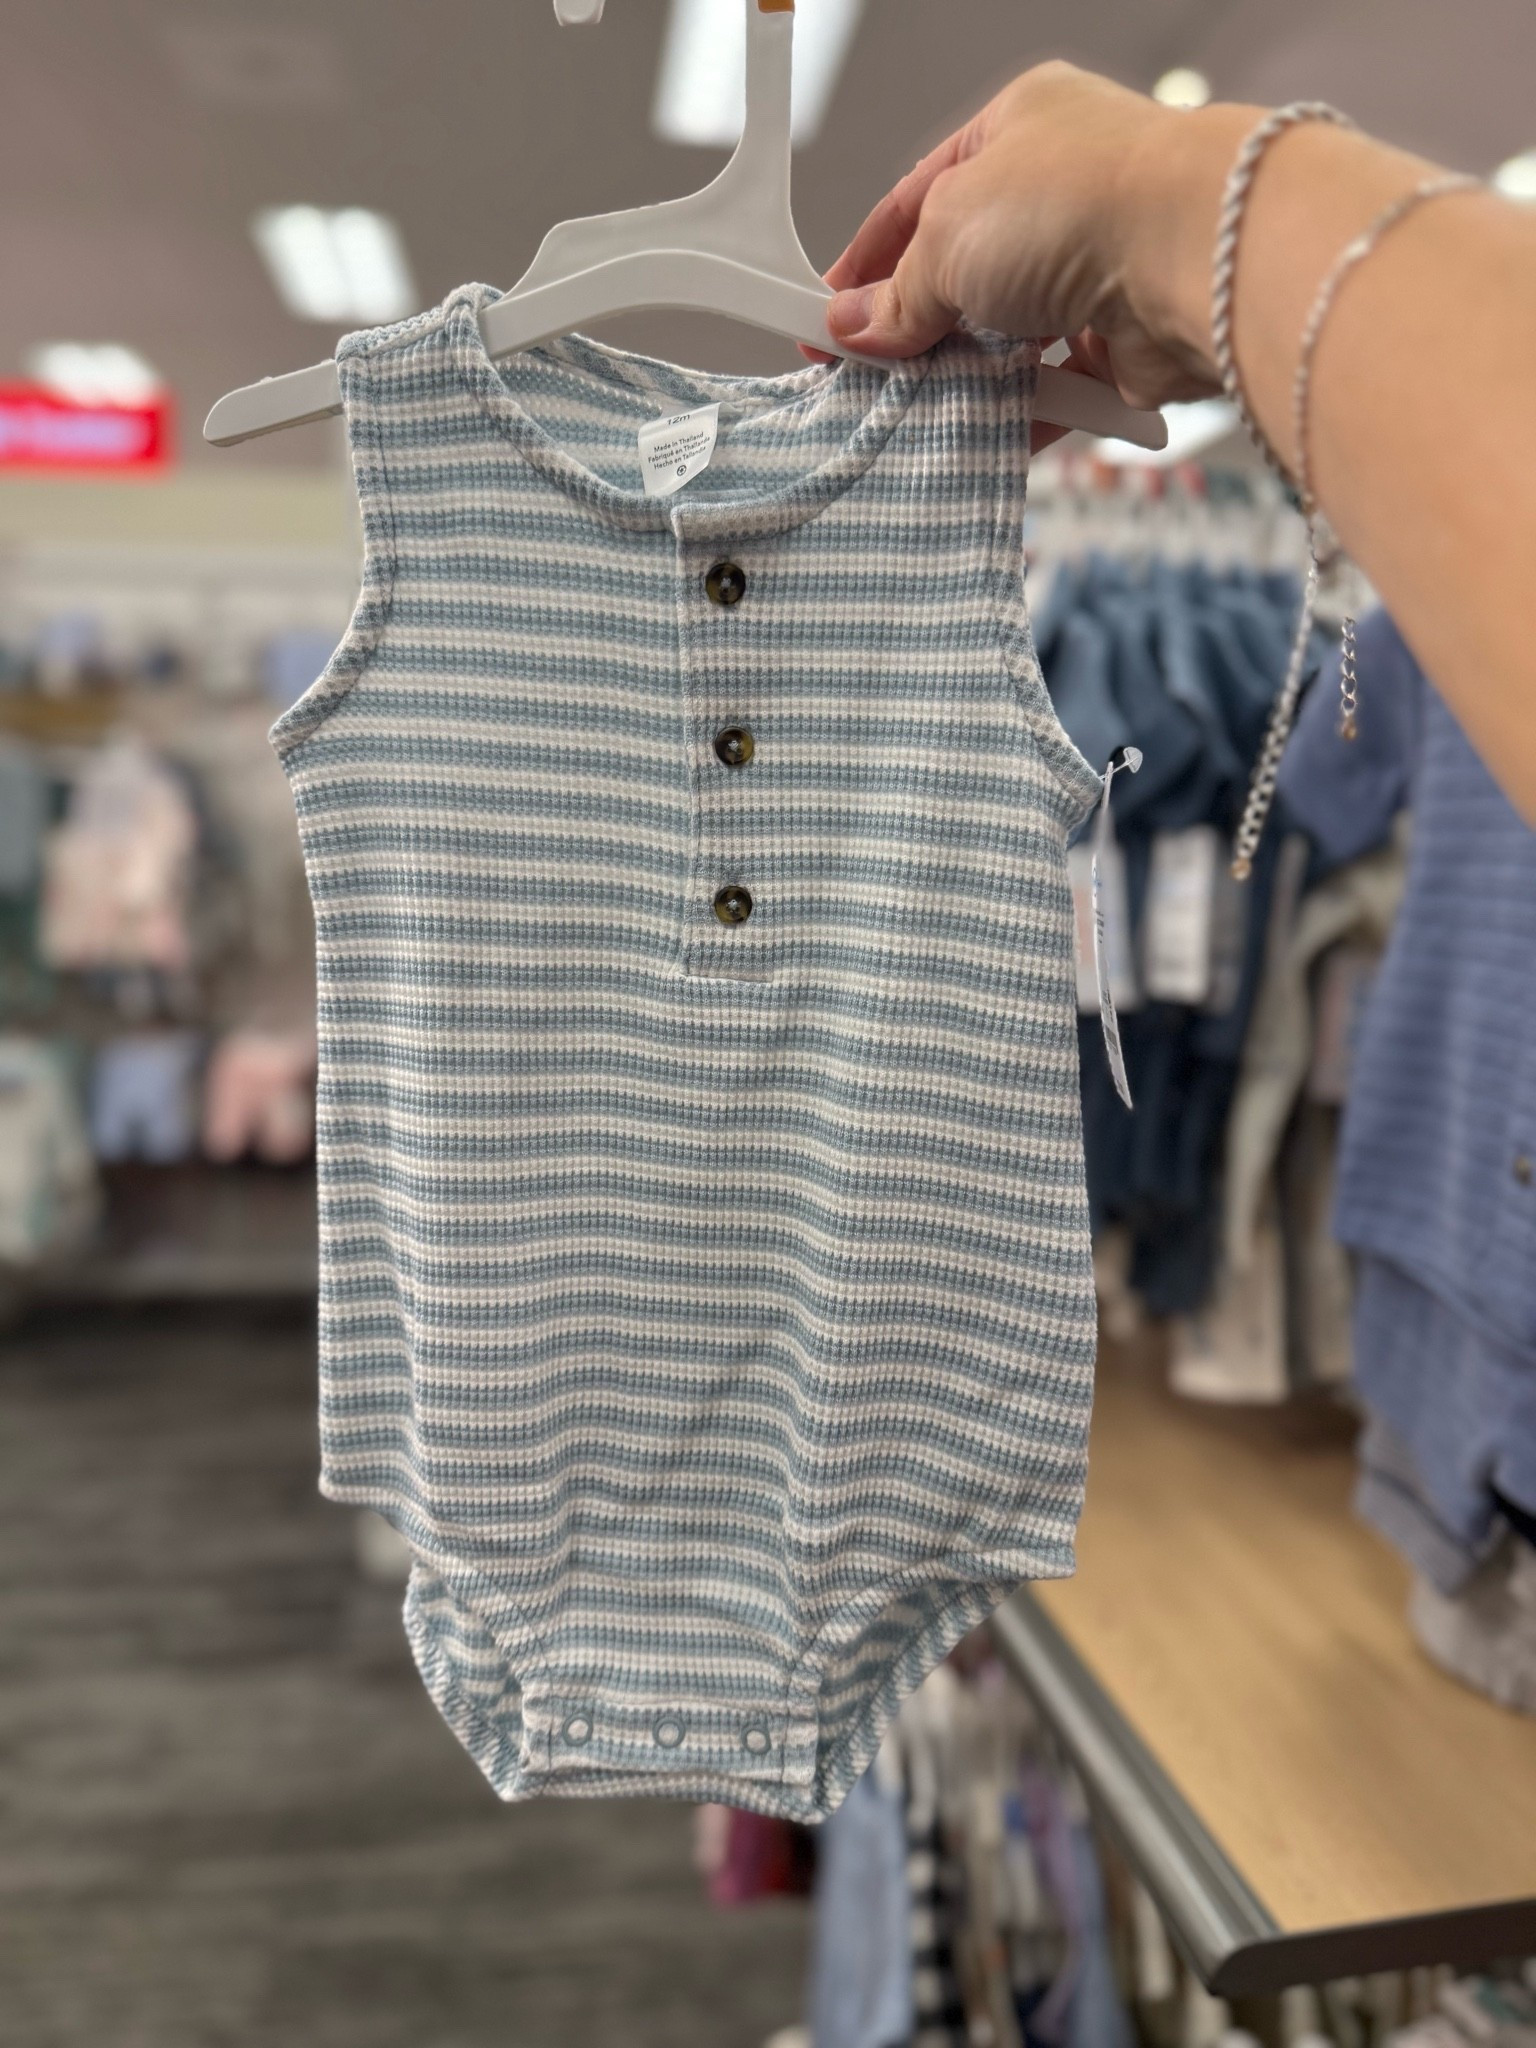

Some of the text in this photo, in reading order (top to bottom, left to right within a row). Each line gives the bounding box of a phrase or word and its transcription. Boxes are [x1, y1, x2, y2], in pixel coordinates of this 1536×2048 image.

[667, 414, 690, 425] 12m
[654, 443, 671, 453] Made
[679, 432, 704, 445] Thailand
[654, 460, 673, 470] Hecho
